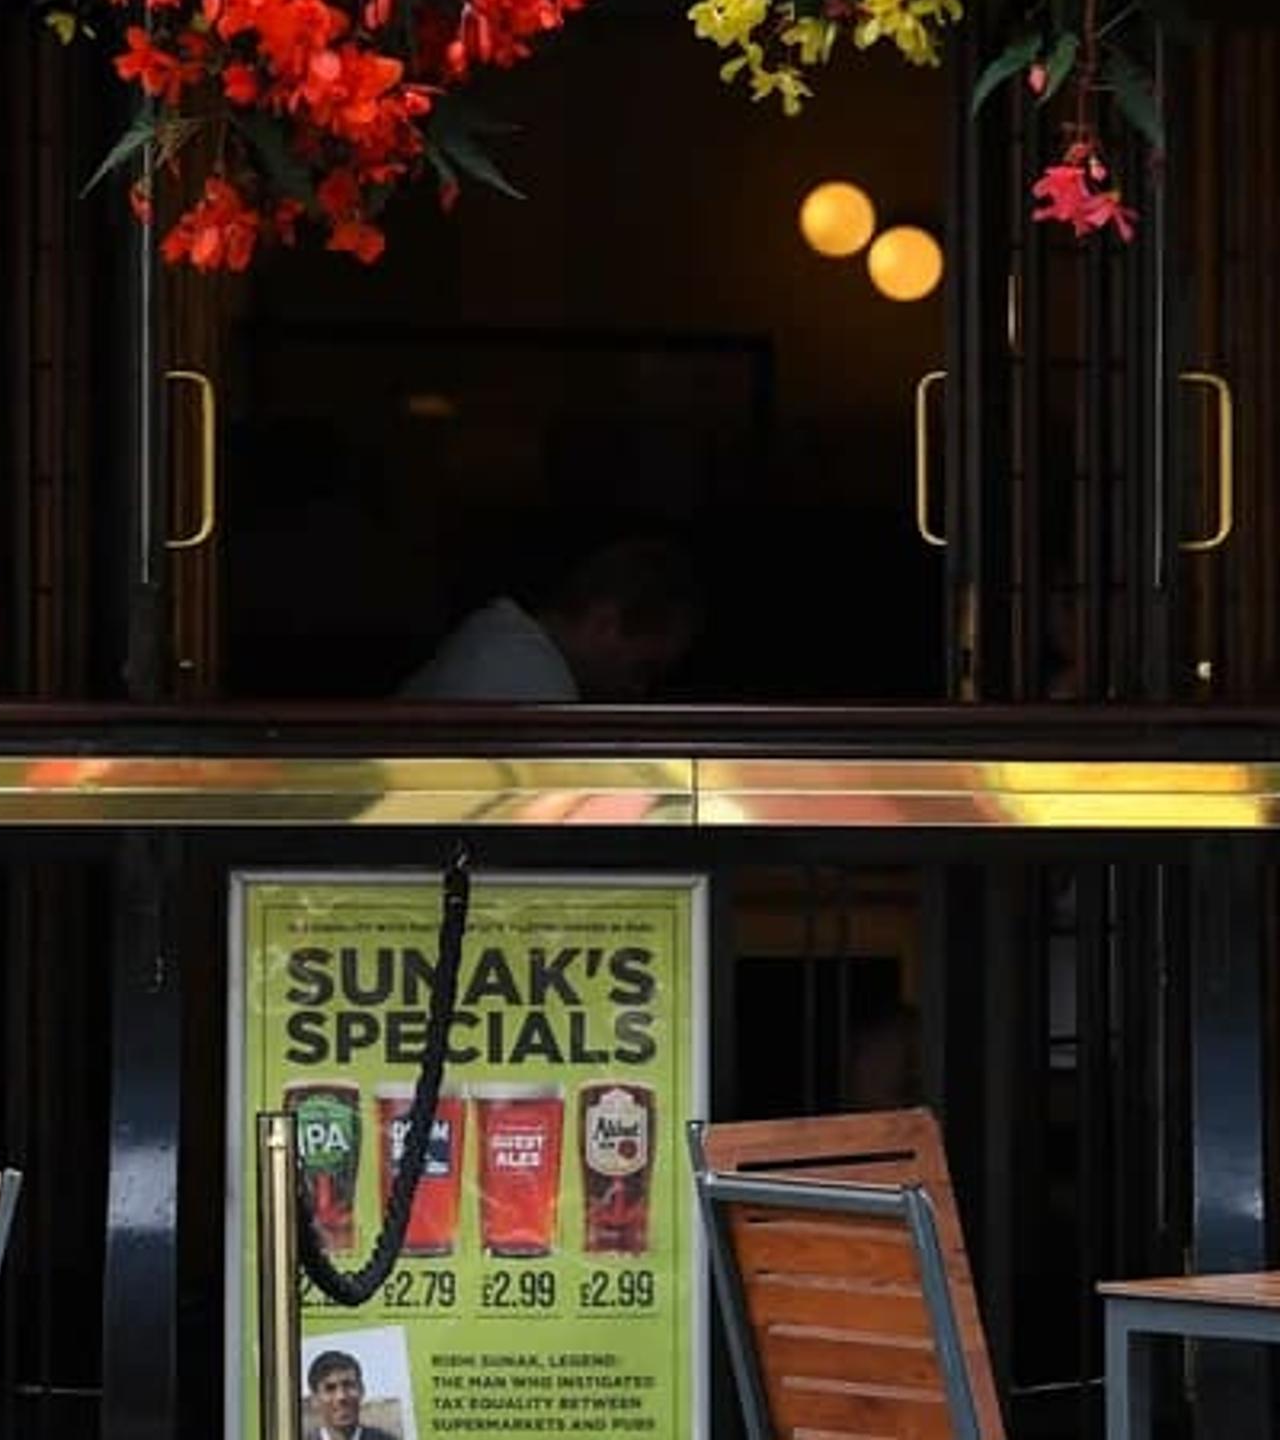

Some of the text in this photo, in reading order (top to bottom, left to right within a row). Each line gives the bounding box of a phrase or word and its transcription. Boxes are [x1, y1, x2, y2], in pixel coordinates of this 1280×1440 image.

[286, 947, 656, 1007] SUNAK'S
[286, 1011, 658, 1064] SPECIALS
[482, 1271, 556, 1307] £2.99
[580, 1271, 654, 1307] £2.99
[432, 1376, 464, 1388] THE
[469, 1376, 507, 1388] MAN
[512, 1376, 552, 1388] WHO
[432, 1398, 642, 1410] TAX EQUALITY BETWEEN
[432, 1418, 565, 1431] SUPERMARKETS
[572, 1418, 606, 1431] AND
